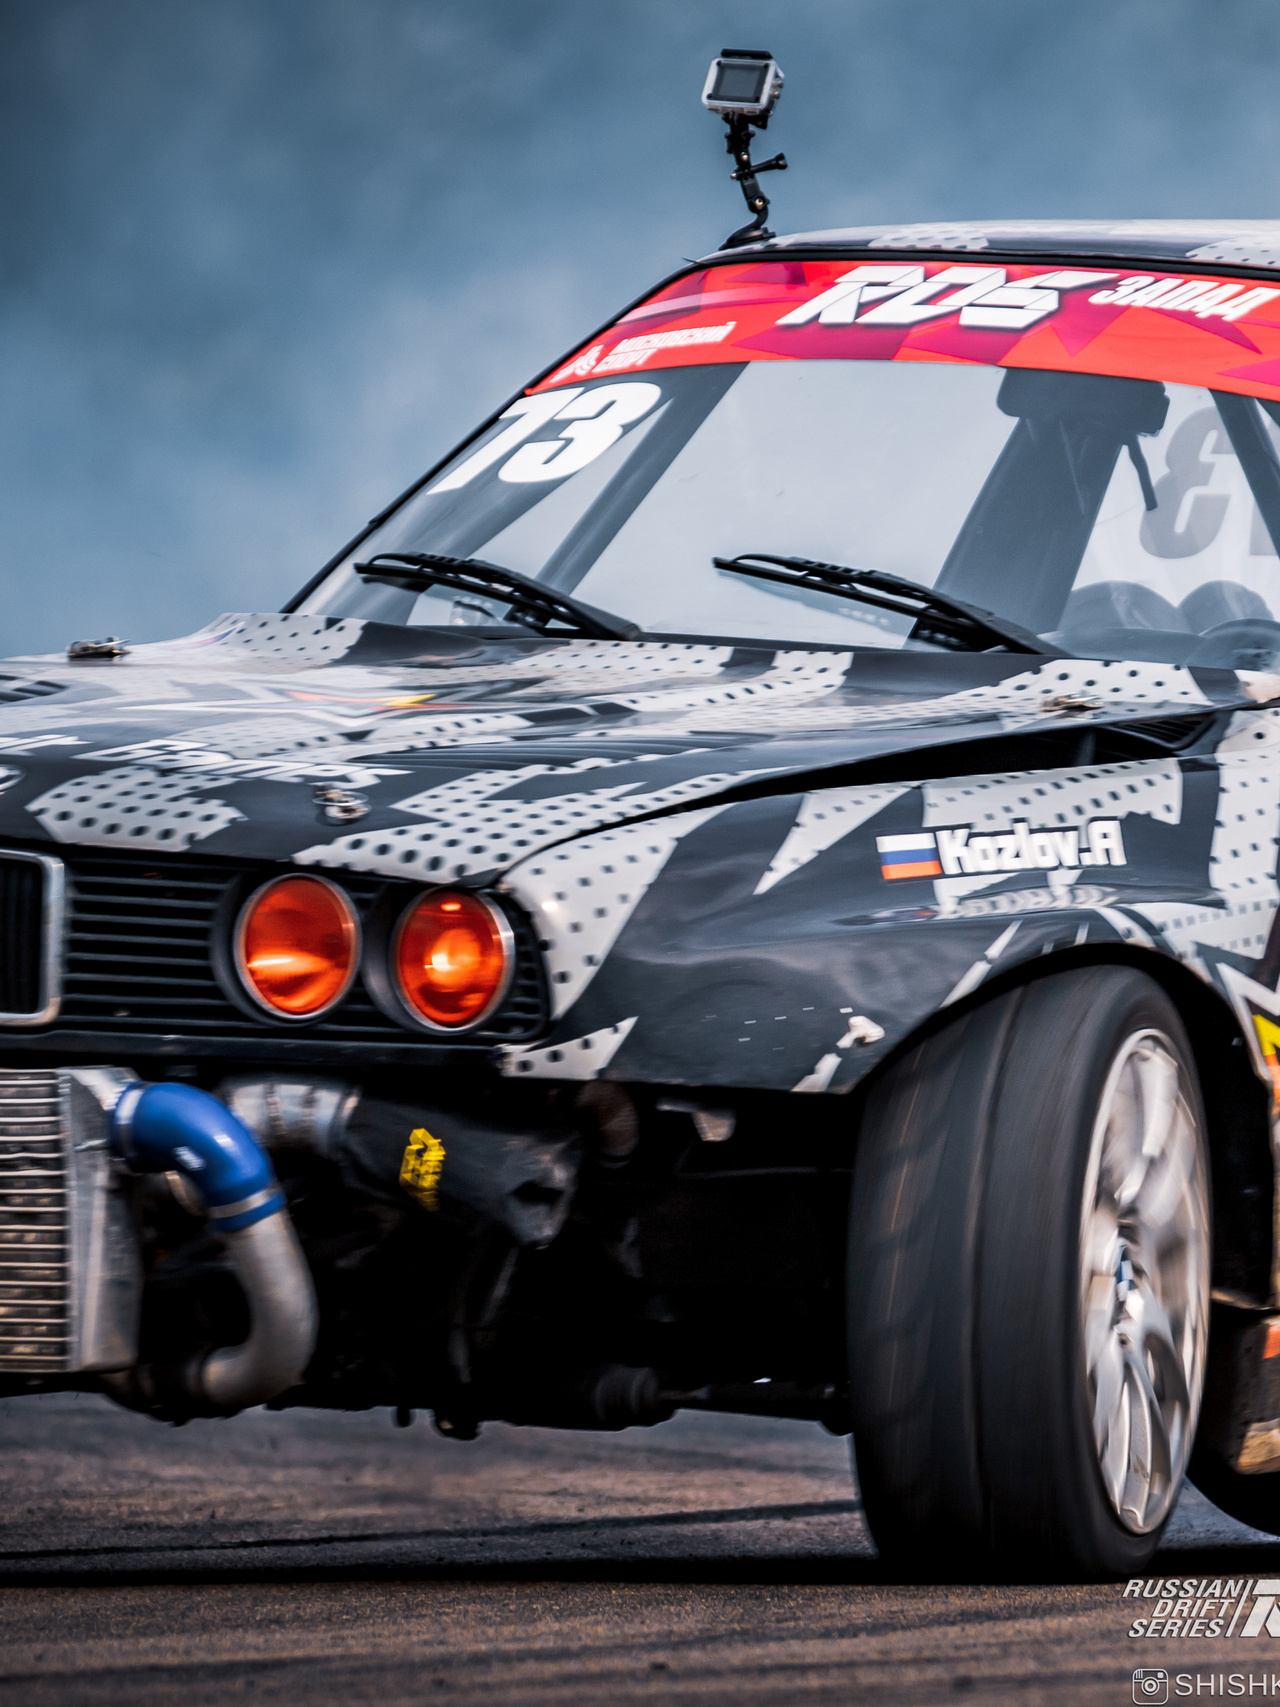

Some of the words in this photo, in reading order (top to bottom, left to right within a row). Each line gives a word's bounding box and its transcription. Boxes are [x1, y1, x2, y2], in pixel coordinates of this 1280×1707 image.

[775, 265, 1120, 327] RDS
[425, 382, 662, 495] 73
[936, 820, 1128, 875] Kozlov.A
